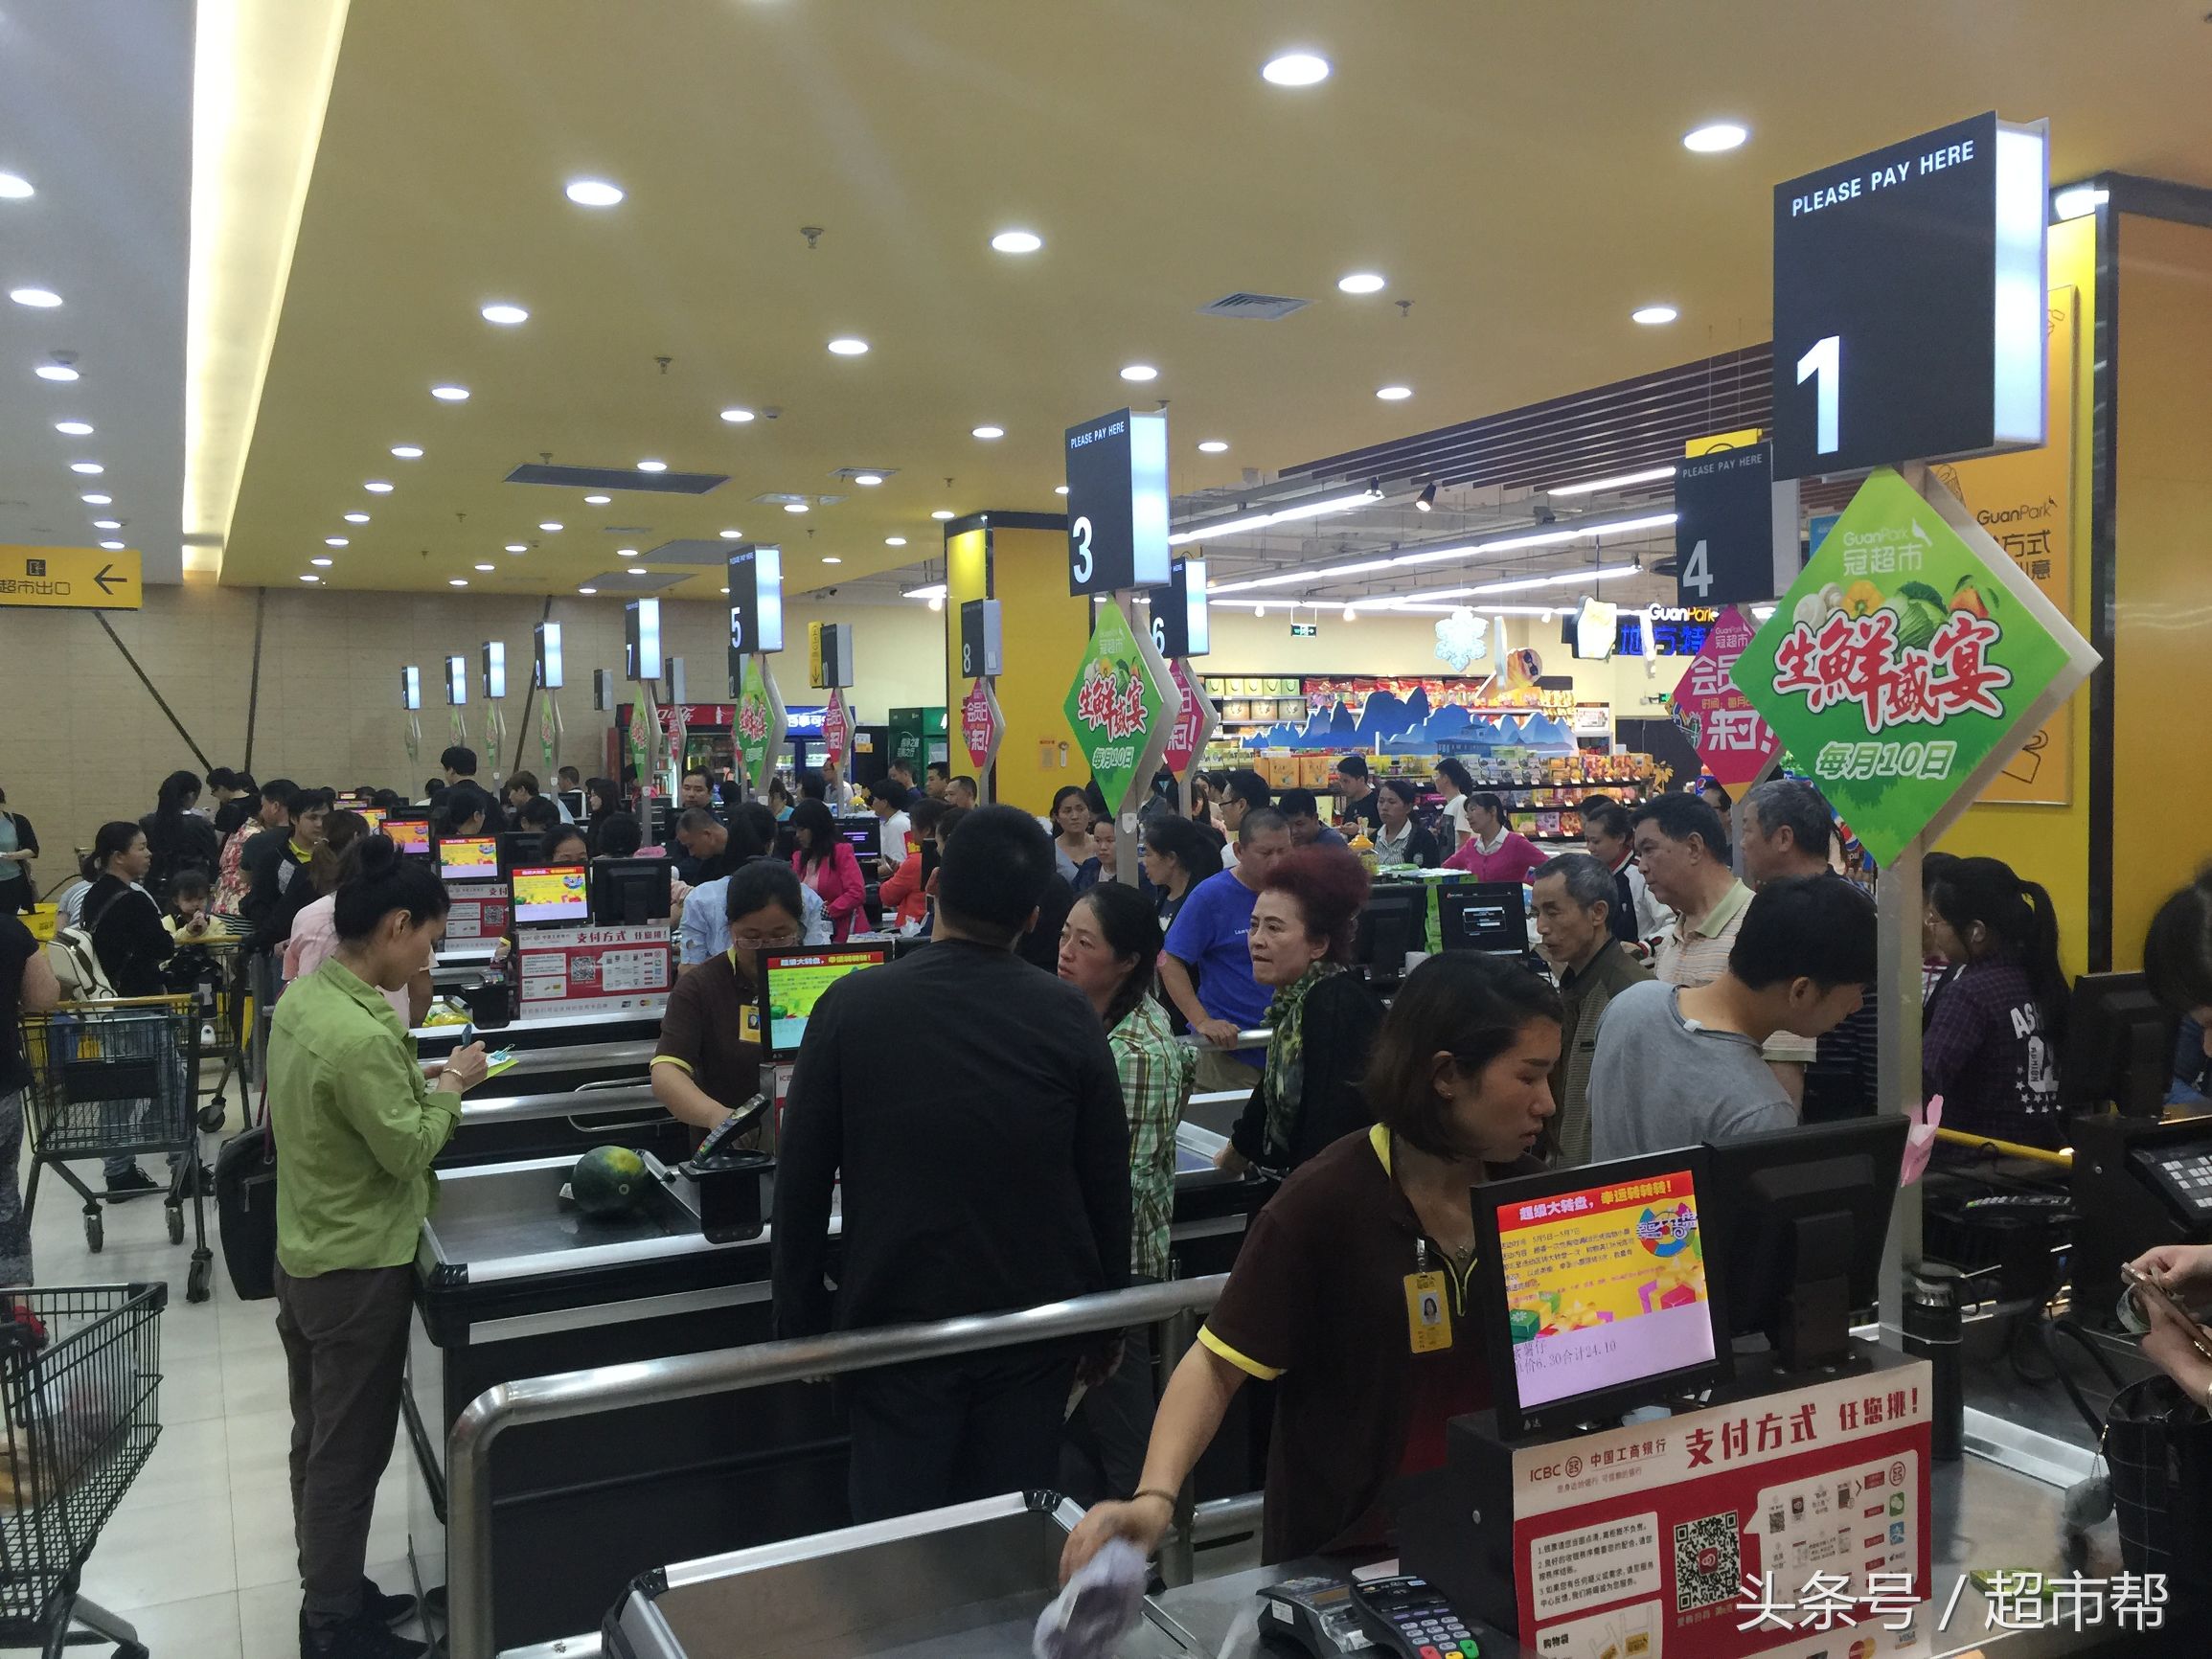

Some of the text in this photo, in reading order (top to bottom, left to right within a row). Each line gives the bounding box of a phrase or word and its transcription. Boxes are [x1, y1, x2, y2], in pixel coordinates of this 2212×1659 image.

[1791, 140, 1973, 216] PLEASE PAY HERE
[1796, 335, 1840, 455] 1
[1070, 421, 1125, 449] PLEASE PAY HERE
[1682, 453, 1763, 478] PLEASE PAY HERE
[1976, 503, 2052, 526] GuanPark
[1072, 516, 1093, 583] 3
[1843, 526, 1909, 547] GuanPark
[1994, 530, 2051, 557] 方式
[1682, 539, 1714, 598] 4
[1843, 543, 1923, 577] 冠超市
[0, 579, 71, 596] 超市出口
[731, 606, 741, 649] 5
[1152, 617, 1166, 656] 6
[626, 644, 632, 676] 7
[963, 643, 971, 672] 8
[1815, 740, 1958, 781] 每月10日
[577, 931, 627, 943] 支付方式
[1685, 1402, 1817, 1469] 支付方式
[1590, 1439, 1667, 1467] 中国工商银行
[1530, 1465, 1561, 1482] ICBC
[1543, 1633, 1569, 1648] 购物袋
